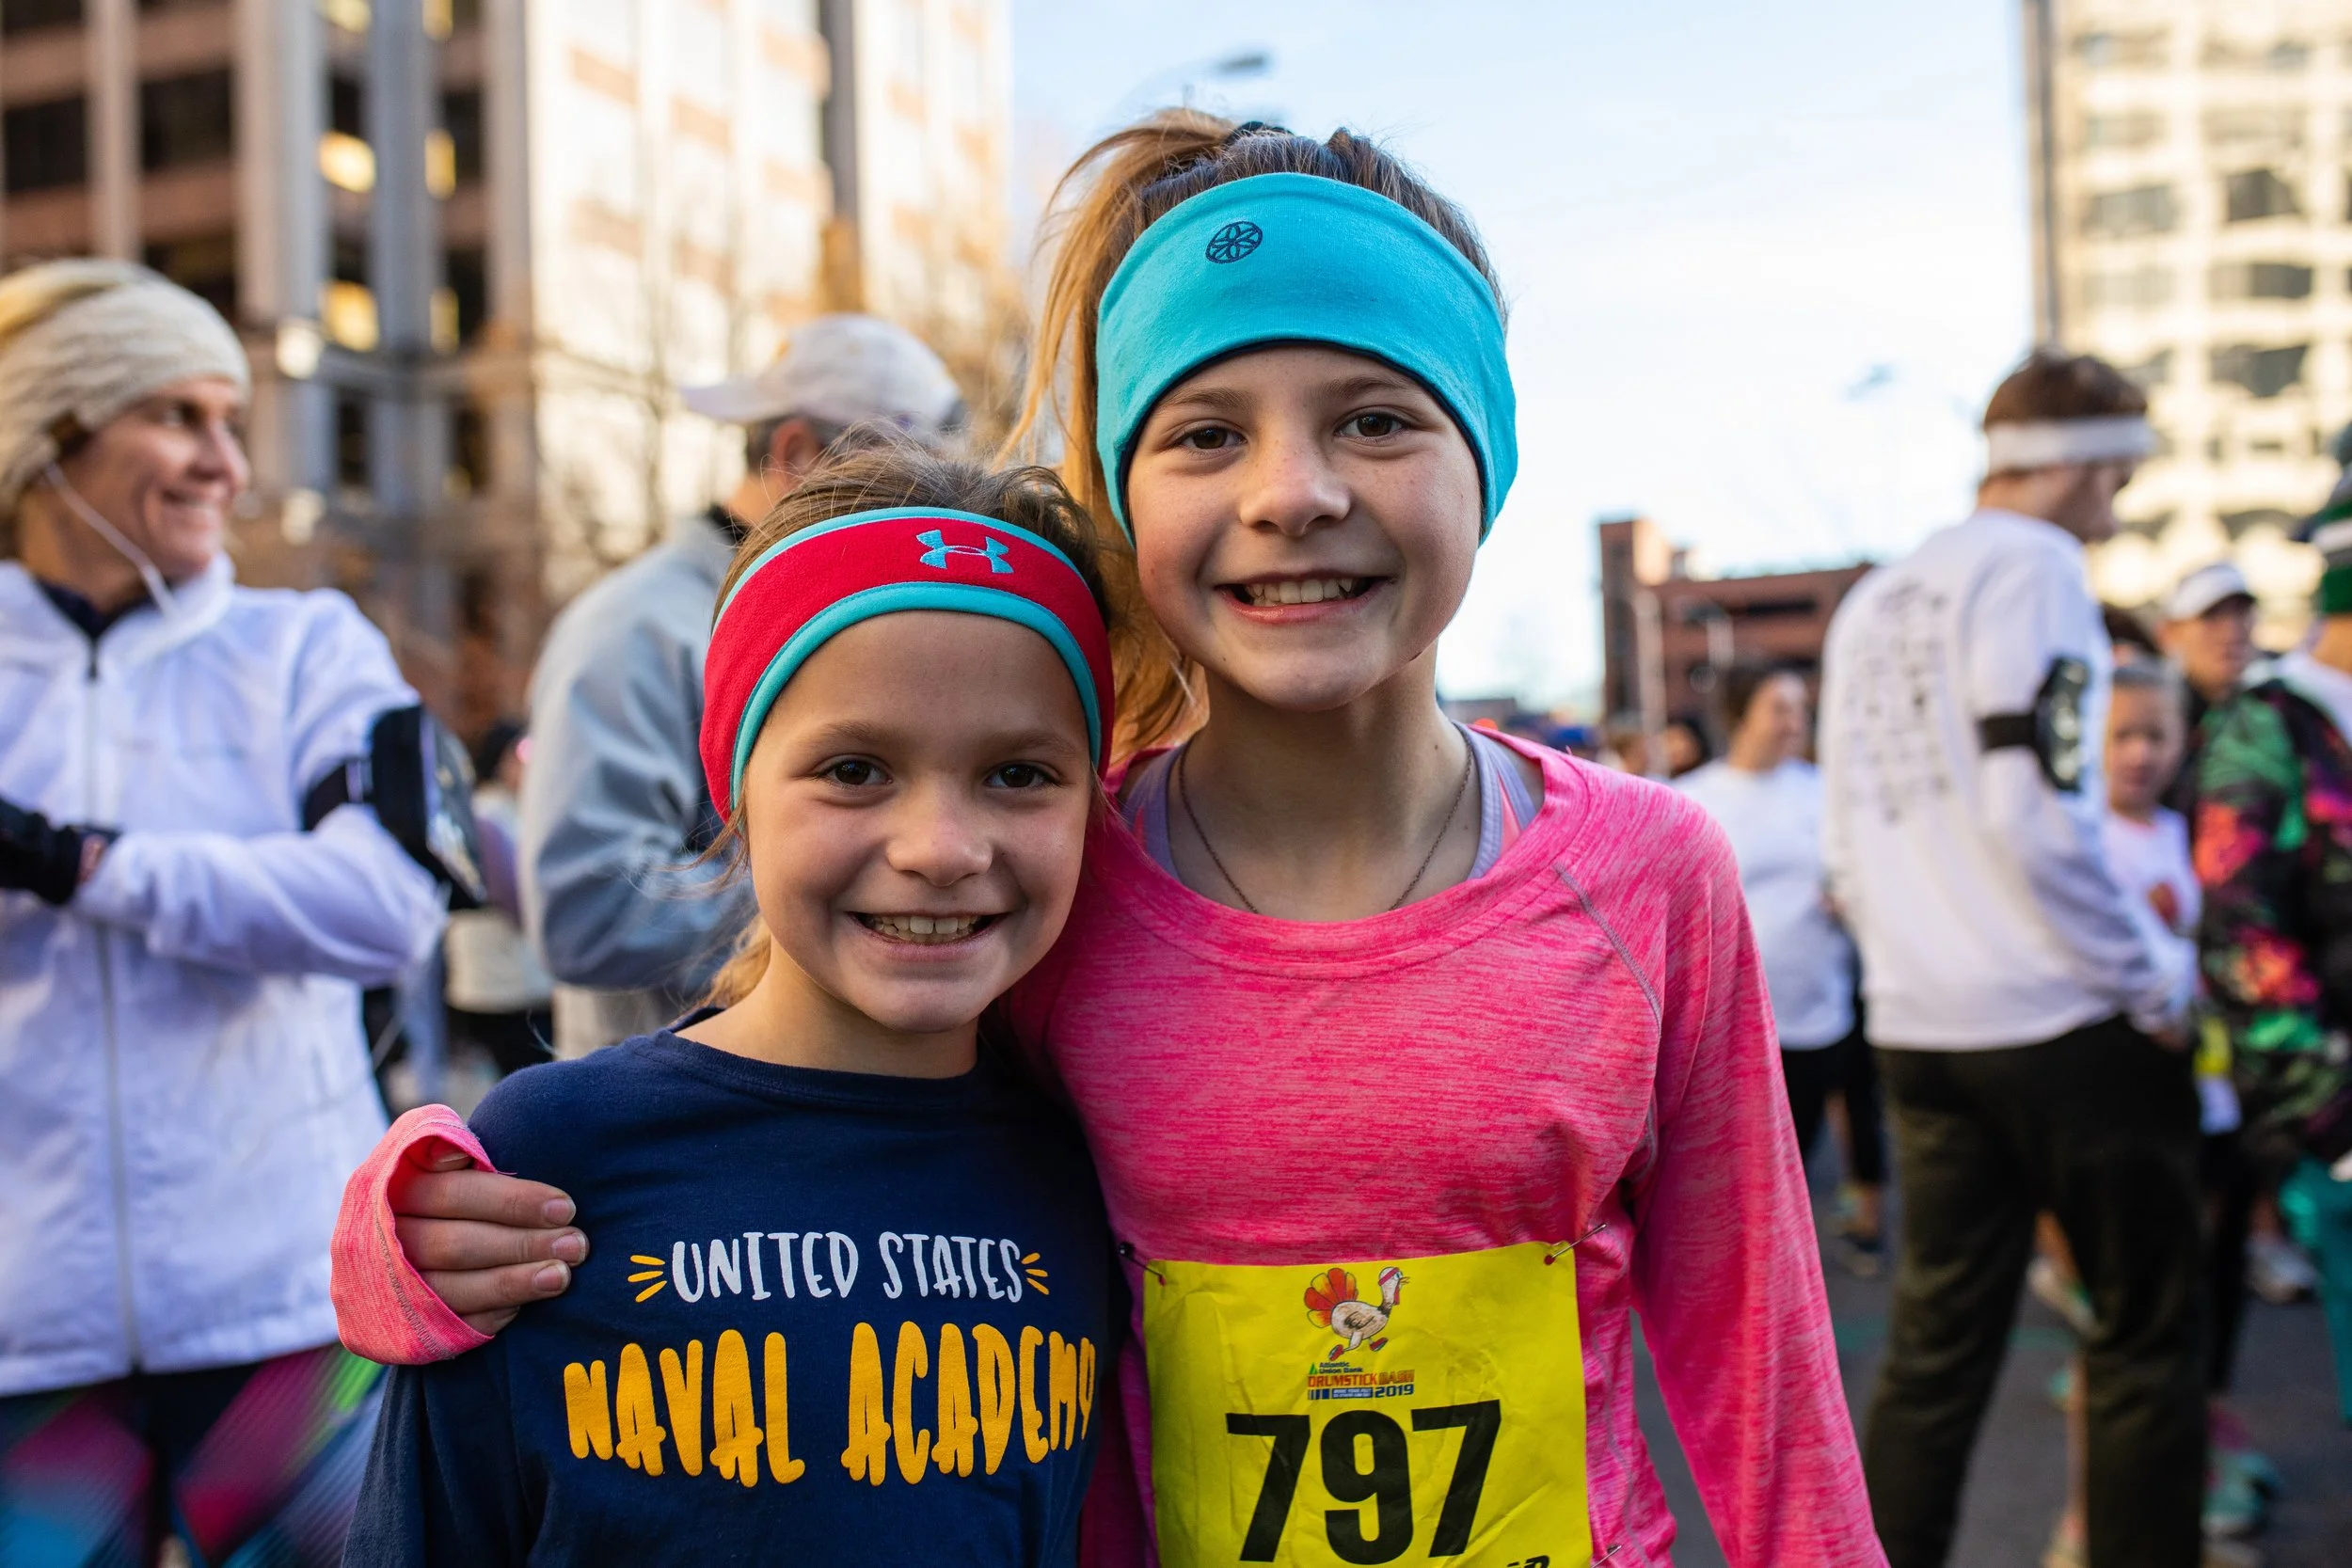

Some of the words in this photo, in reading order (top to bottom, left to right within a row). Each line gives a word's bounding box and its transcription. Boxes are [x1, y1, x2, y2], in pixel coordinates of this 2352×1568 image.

[672, 1231, 859, 1304] UNITED
[879, 1231, 1022, 1304] STATES
[564, 1328, 806, 1488] NAVAL
[841, 1321, 1096, 1487] ACADEMY
[1308, 1373, 1377, 1387] DRUMSTICK
[1378, 1370, 1414, 1385] DASH
[1375, 1384, 1414, 1398] 2019
[1225, 1399, 1502, 1566] 797
